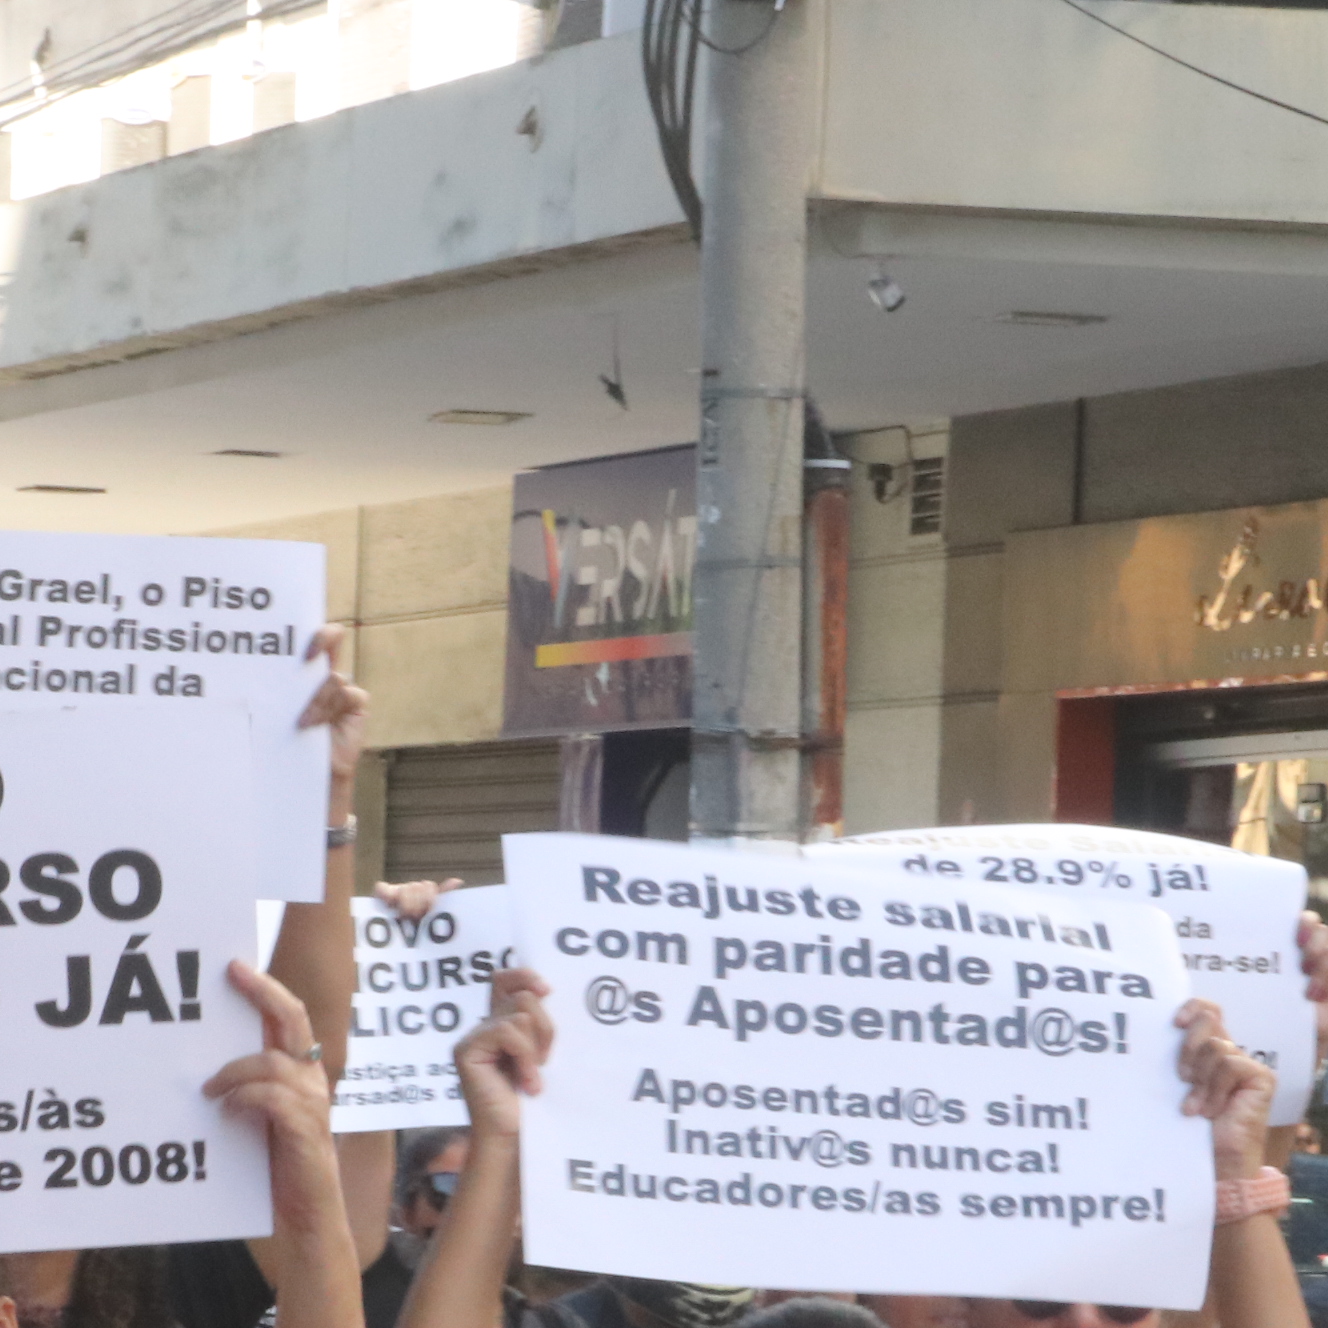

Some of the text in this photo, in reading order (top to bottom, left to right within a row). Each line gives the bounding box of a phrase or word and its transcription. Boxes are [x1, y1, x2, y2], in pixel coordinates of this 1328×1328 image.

[140, 583, 166, 607] o
[182, 576, 273, 611] Piso
[37, 616, 296, 657] Profissional
[153, 665, 205, 699] da
[903, 853, 1210, 897] de 28.9% já!
[364, 912, 456, 949] OVO
[581, 864, 1113, 953] Reajuste salarial
[34, 933, 203, 1029] JÁ!
[555, 926, 1154, 999] com paridade para
[586, 975, 1130, 1057] @s Aposentad@s!
[632, 1067, 1089, 1130] Aposentad@s sim!
[44, 1140, 208, 1190] 2008!
[665, 1118, 1060, 1173] Inativ@s nunca!
[566, 1159, 1168, 1227] Educadores/as sempre!
